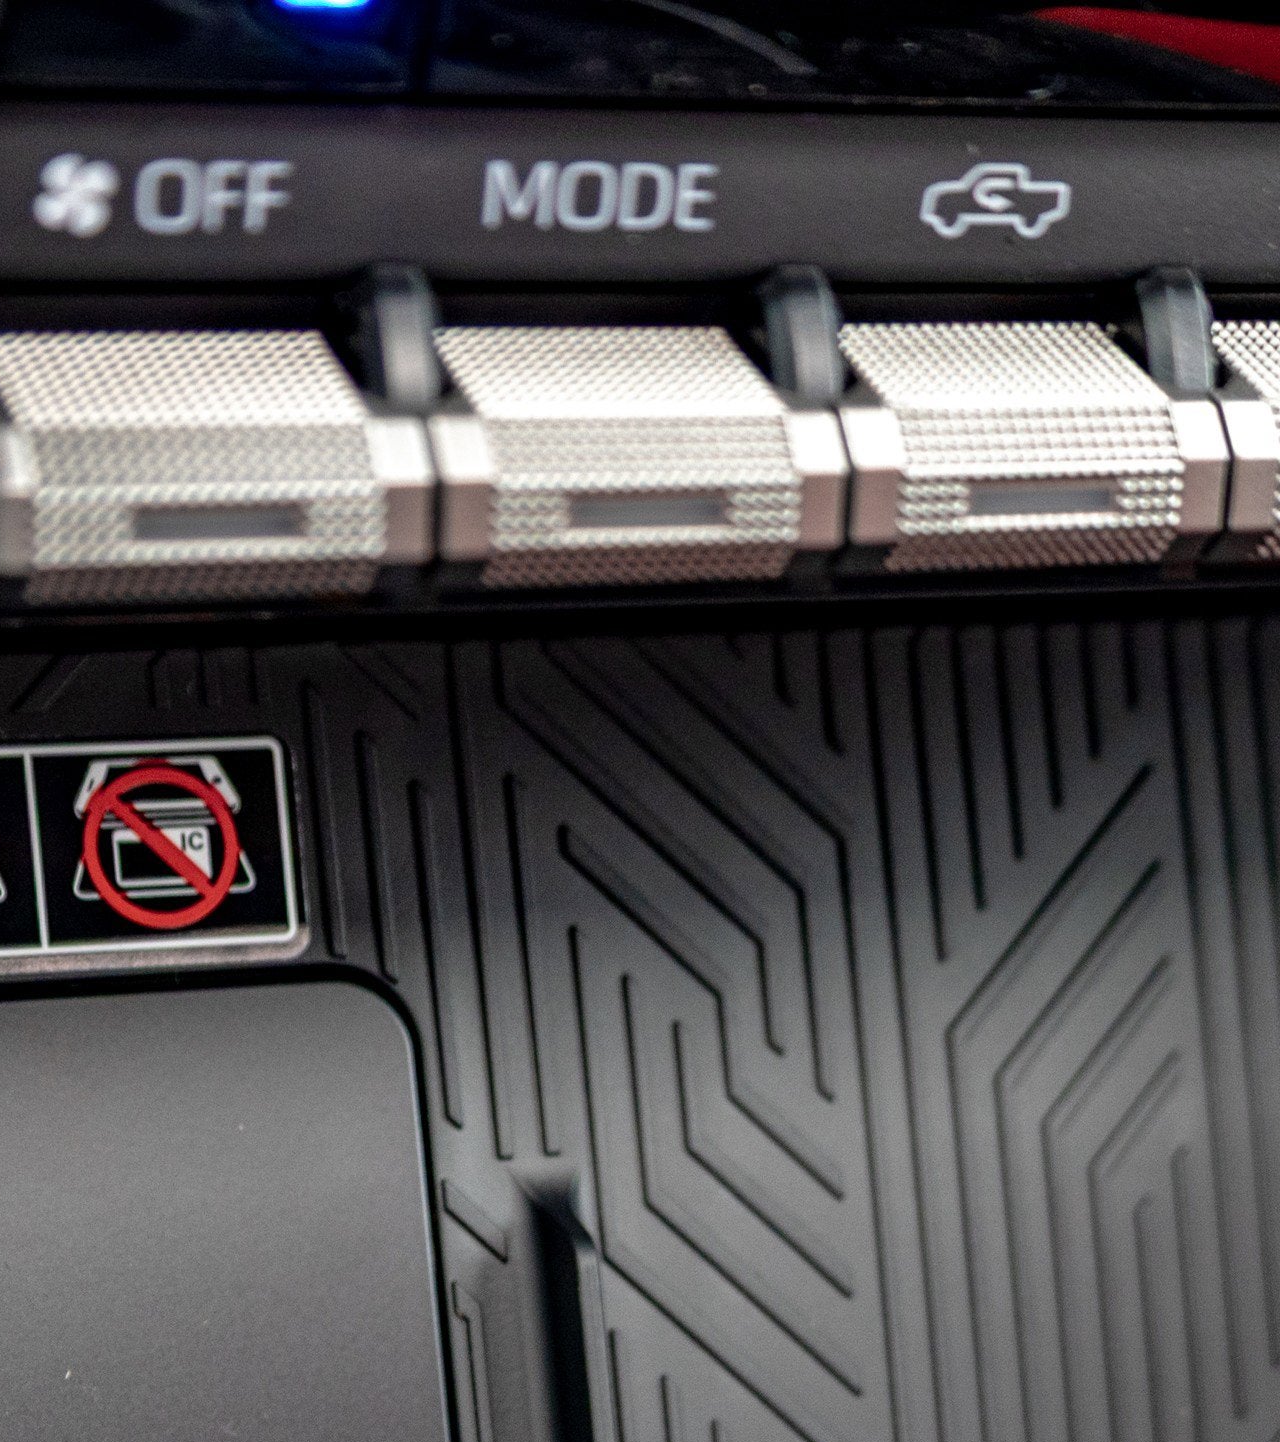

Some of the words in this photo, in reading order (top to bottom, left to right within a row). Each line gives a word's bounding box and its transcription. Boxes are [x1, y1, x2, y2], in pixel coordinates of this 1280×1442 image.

[134, 157, 293, 235] OFF
[481, 158, 719, 231] MODE
[181, 831, 204, 851] IC
